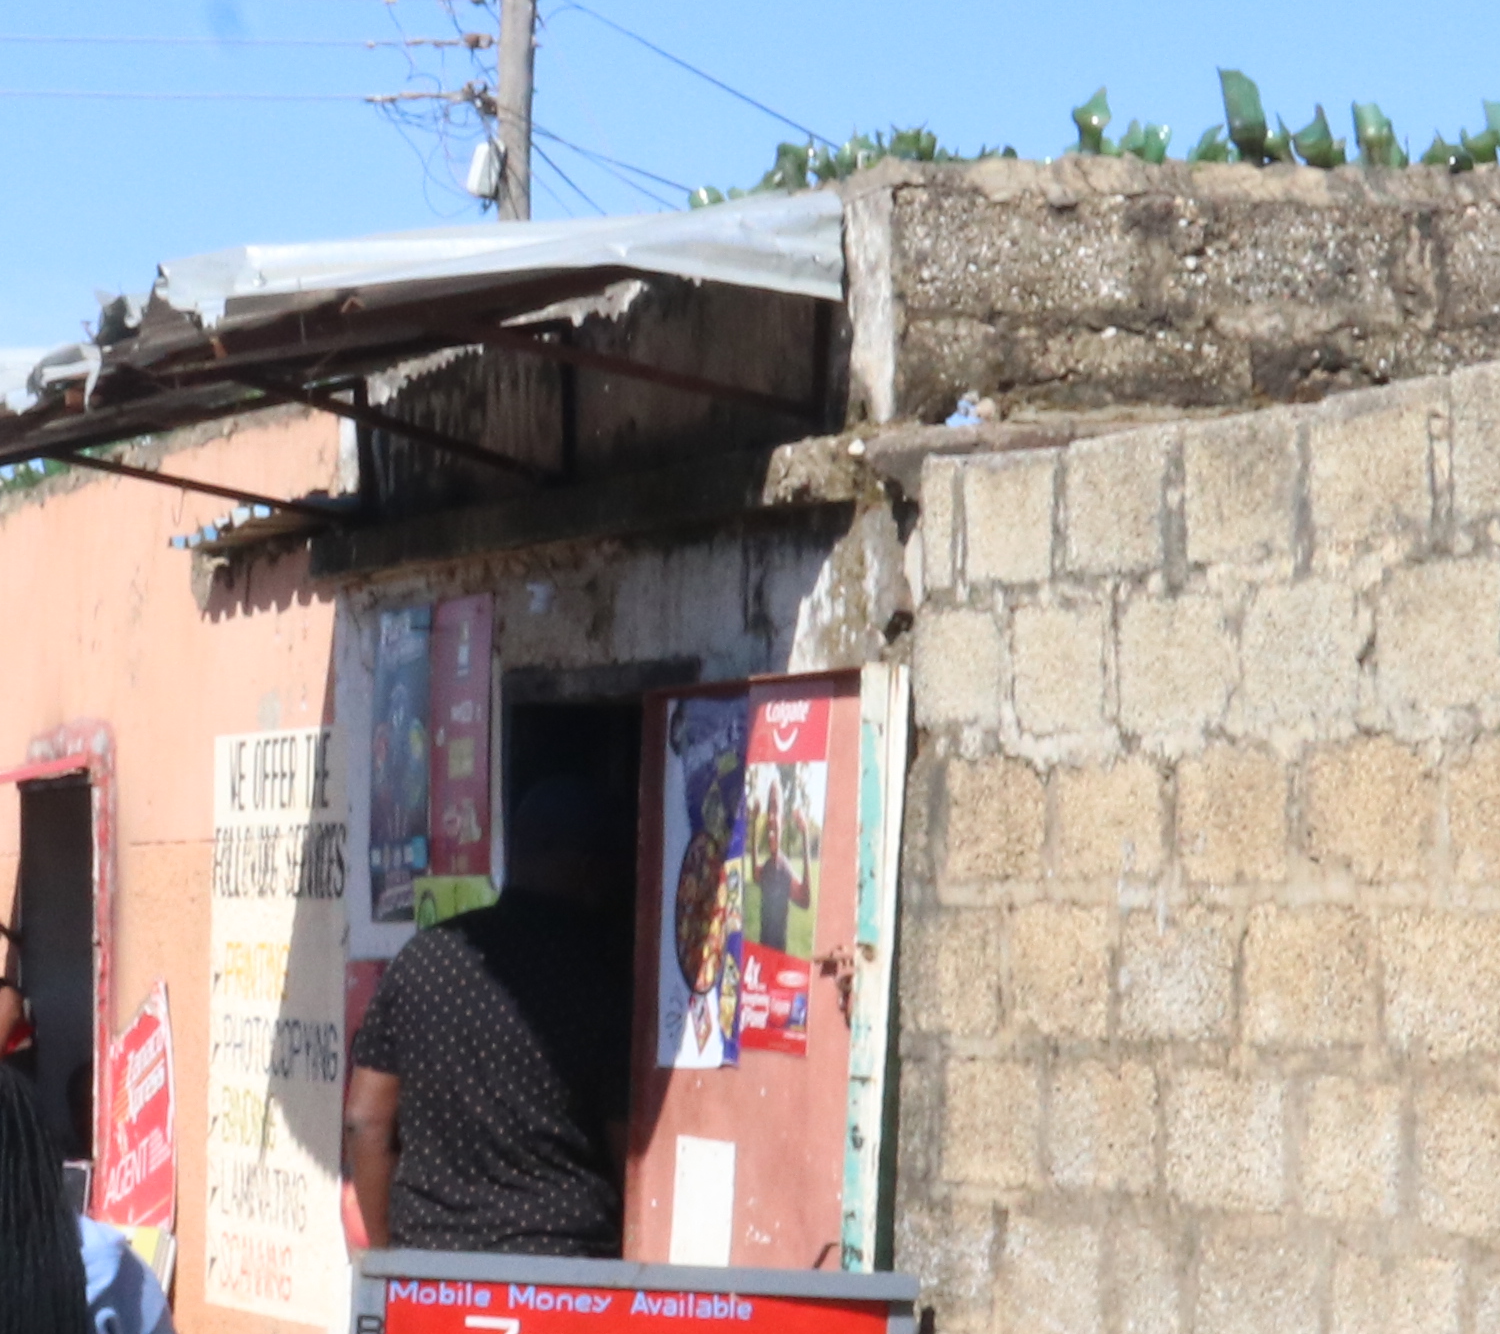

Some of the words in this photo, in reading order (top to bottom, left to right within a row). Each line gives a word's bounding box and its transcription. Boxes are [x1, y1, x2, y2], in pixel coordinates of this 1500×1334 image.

[765, 698, 812, 729] Colgate
[229, 739, 247, 811] WE
[253, 735, 299, 811] OFFER
[305, 731, 331, 809] THE
[284, 821, 347, 899] SERVICES
[223, 1014, 338, 1083] PHOTOCOPYING
[103, 1135, 150, 1210] AGENT
[387, 1280, 492, 1308] Mobile
[507, 1283, 613, 1314] Money
[630, 1290, 754, 1320] Available
